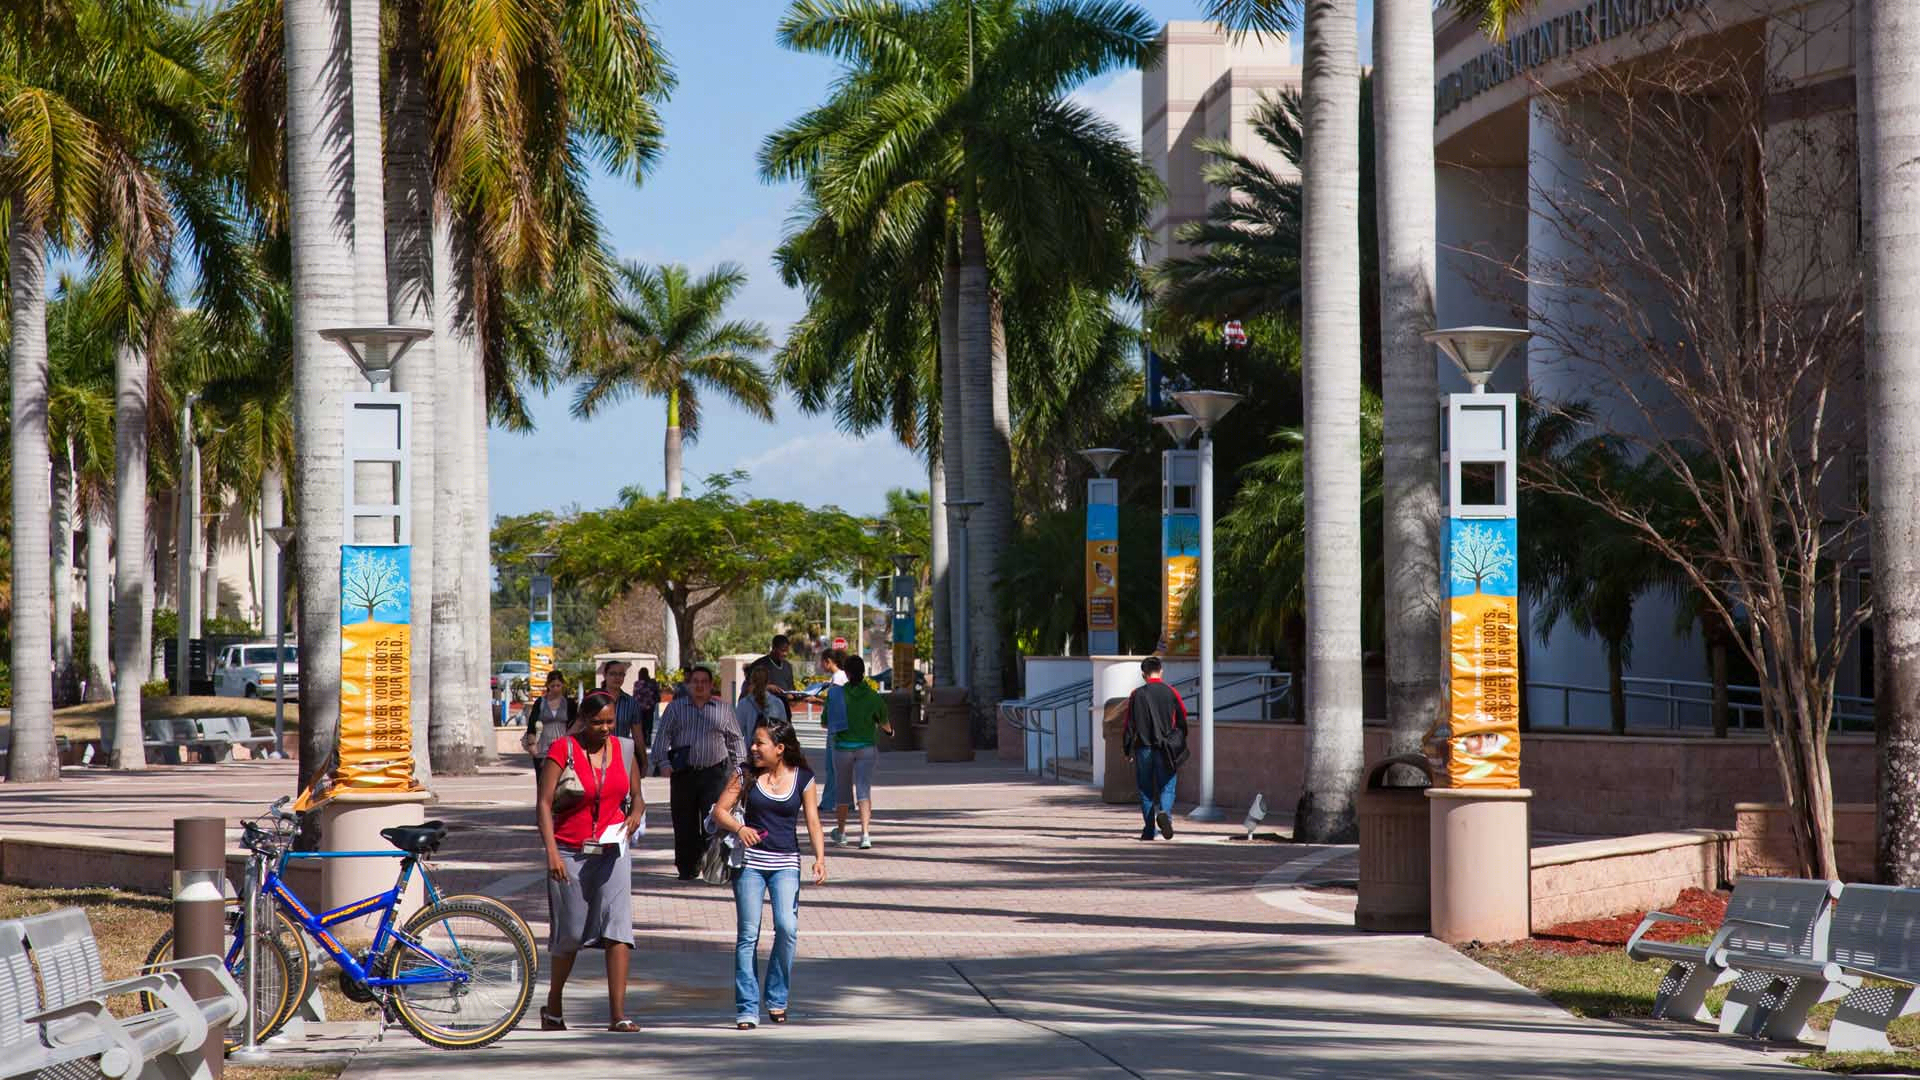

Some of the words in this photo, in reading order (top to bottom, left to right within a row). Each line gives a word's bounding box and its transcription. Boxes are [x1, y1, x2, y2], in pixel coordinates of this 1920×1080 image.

[1484, 608, 1497, 643] ROOTS,
[375, 636, 391, 672] ROOTS,
[390, 631, 403, 674] WORLD...
[1484, 647, 1497, 672] YOUR
[1498, 649, 1511, 673] OUR
[375, 675, 388, 701] YOUR
[390, 676, 402, 702] YOUR
[1498, 675, 1512, 721] DISCOVER
[375, 704, 388, 752] DISCOVER
[390, 705, 402, 752] DISCOVER
